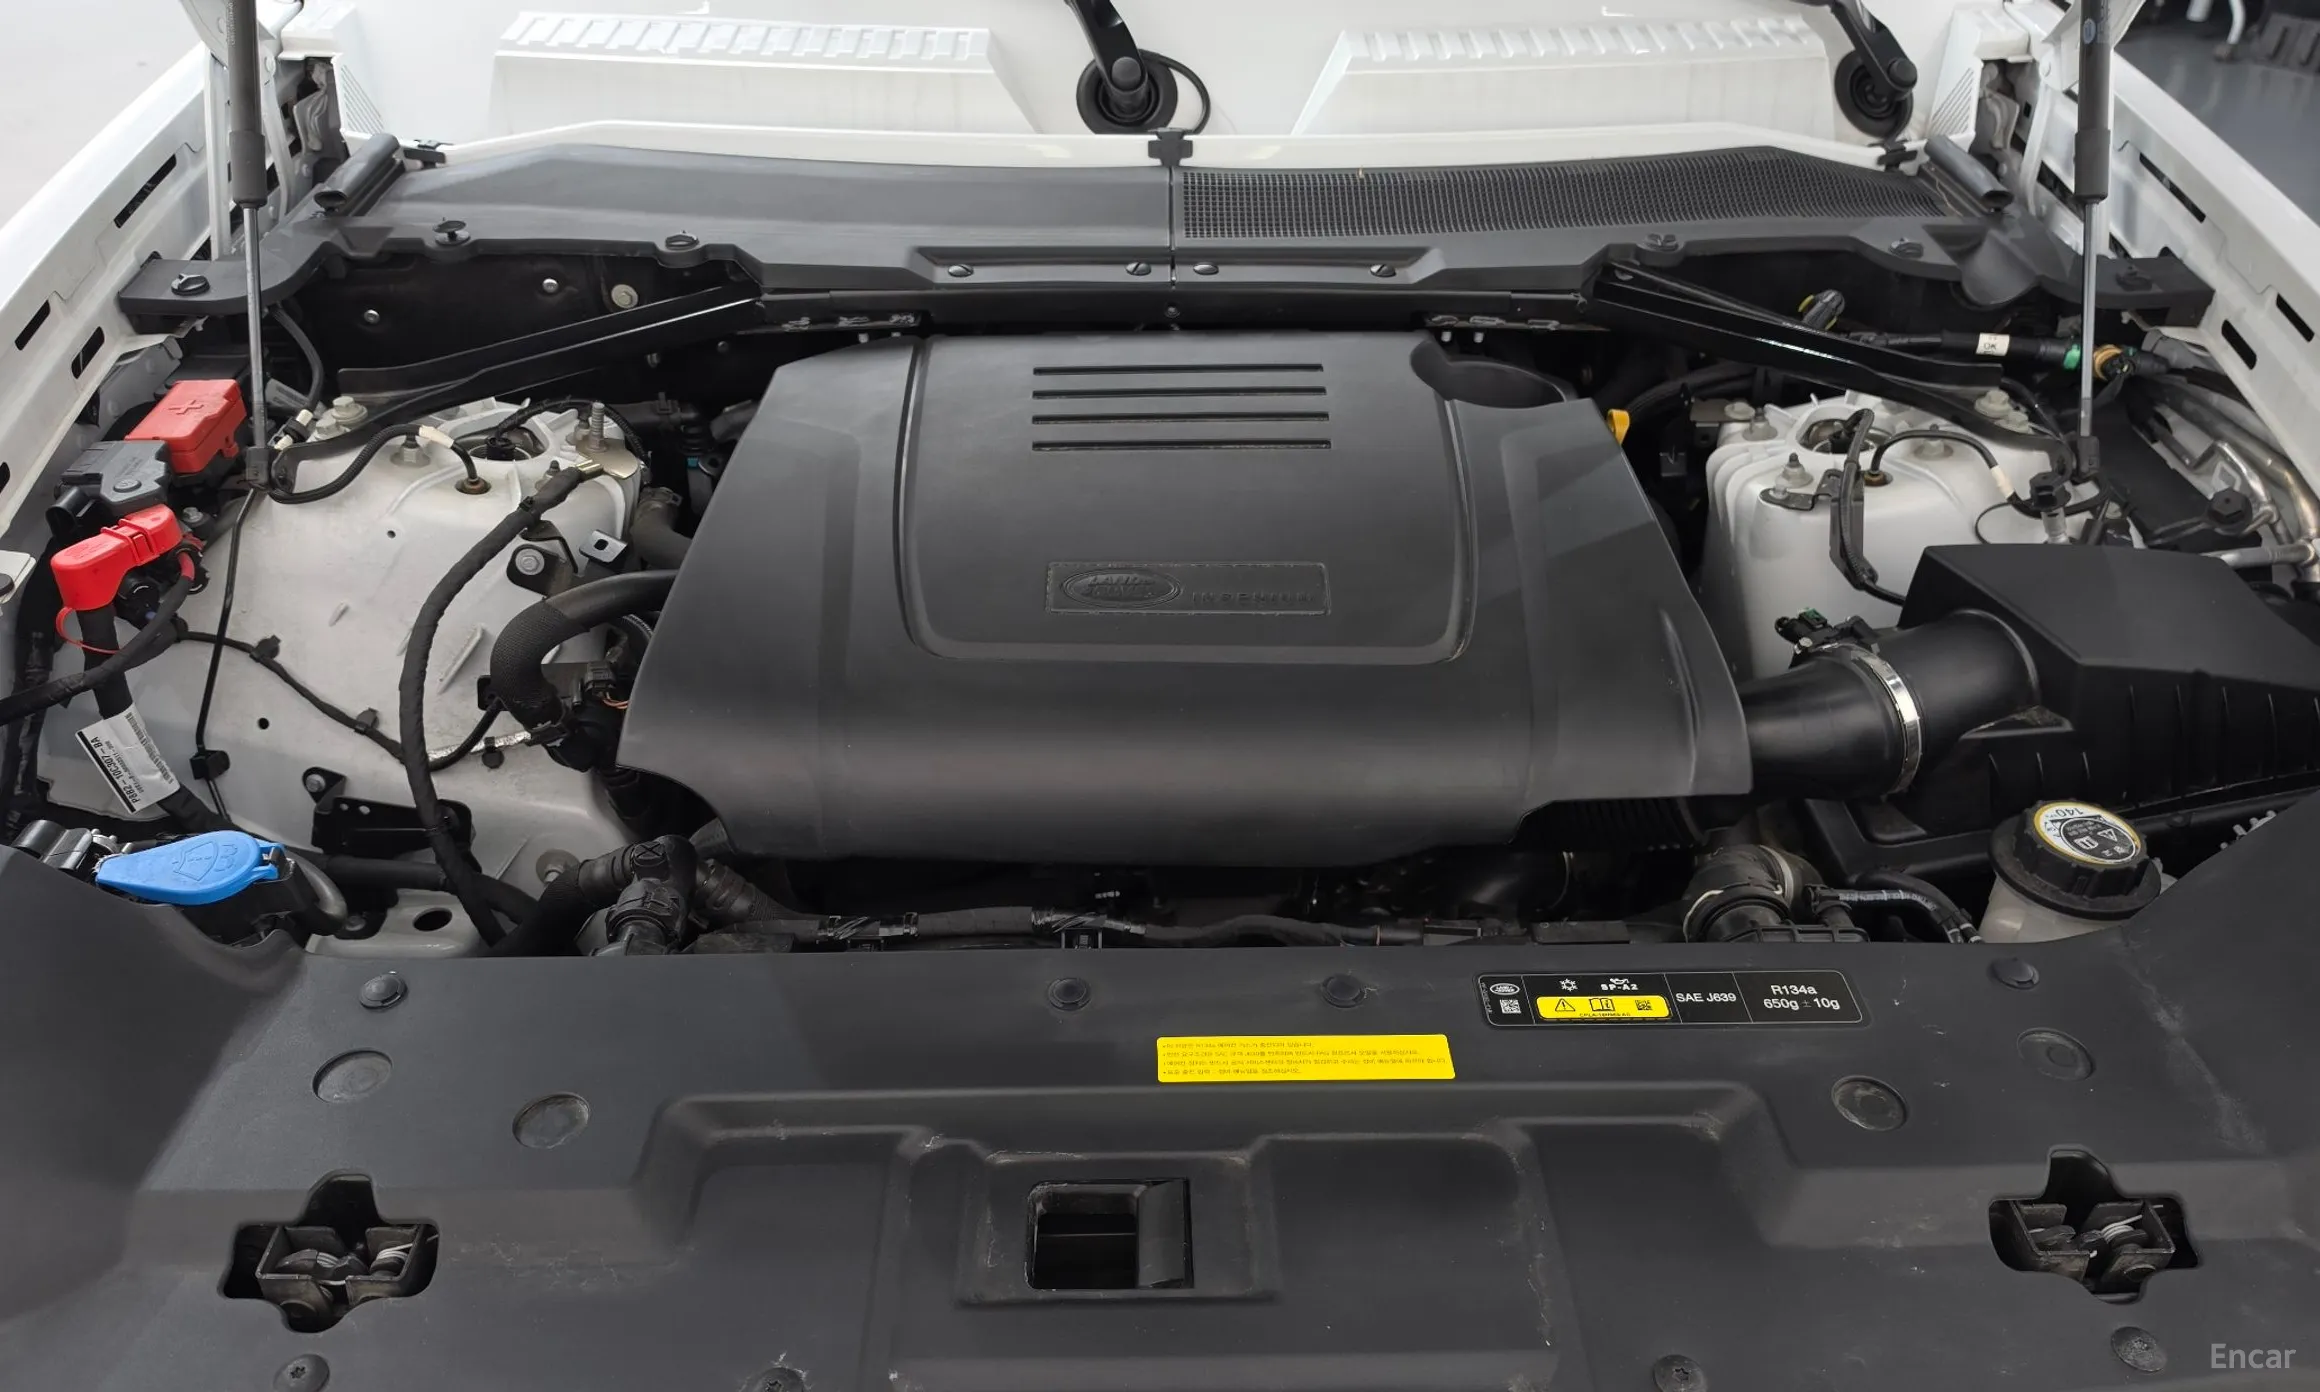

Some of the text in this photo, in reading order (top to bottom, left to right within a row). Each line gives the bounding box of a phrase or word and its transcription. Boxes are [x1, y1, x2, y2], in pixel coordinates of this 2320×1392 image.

[2055, 807, 2083, 818] 140
[1600, 983, 1639, 991] SP-A2
[1770, 984, 1818, 996] R134a
[1675, 992, 1737, 1002] SAE J639
[1763, 998, 1800, 1011] 650g
[1814, 997, 1841, 1010] 10g
